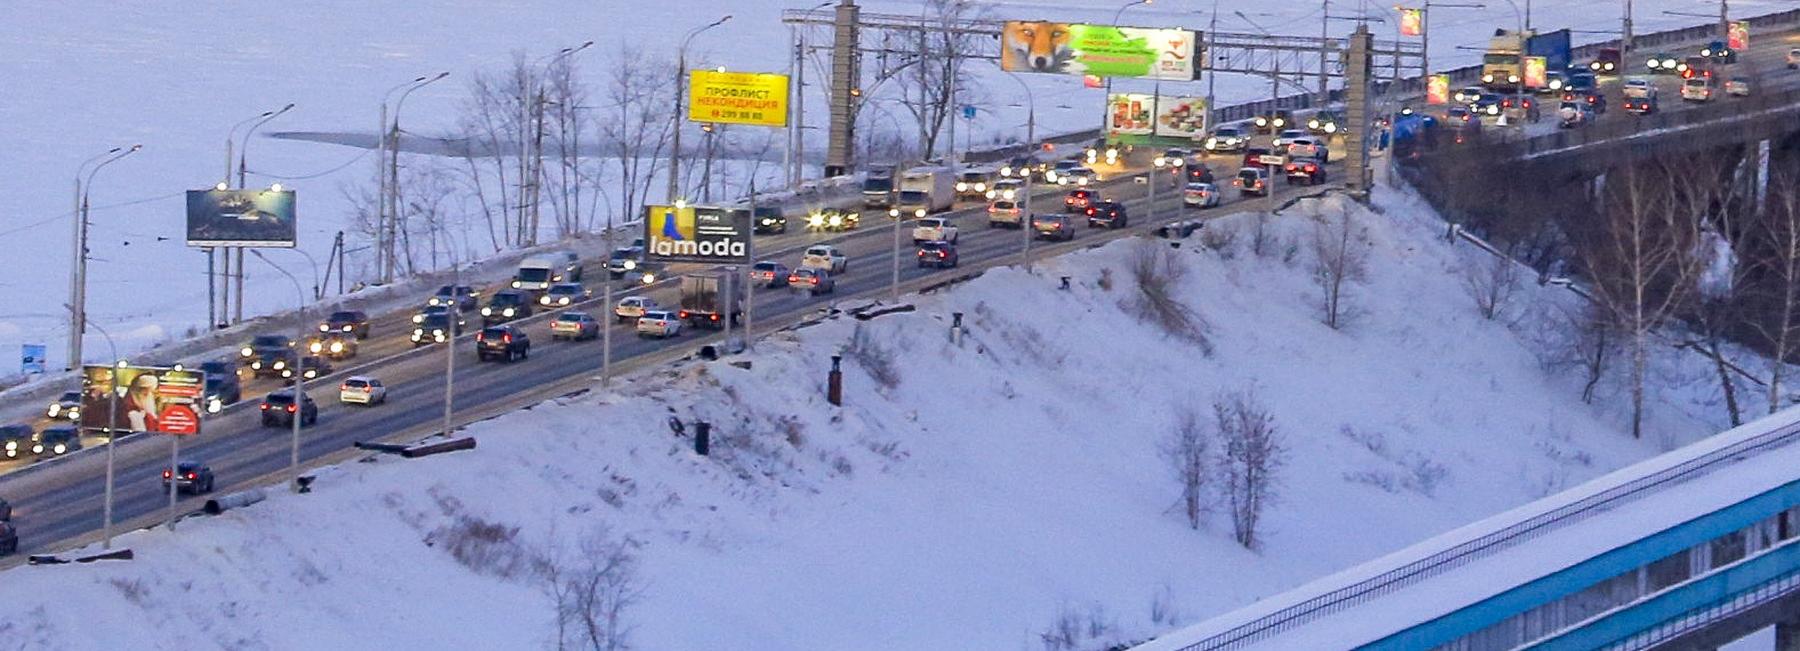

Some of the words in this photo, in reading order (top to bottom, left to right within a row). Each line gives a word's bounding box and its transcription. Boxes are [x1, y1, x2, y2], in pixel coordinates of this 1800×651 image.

[705, 87, 769, 99] ПРОФЛИСТ
[697, 96, 778, 109] НЕКОНДИЦИЯ
[649, 236, 745, 256] lamoda
